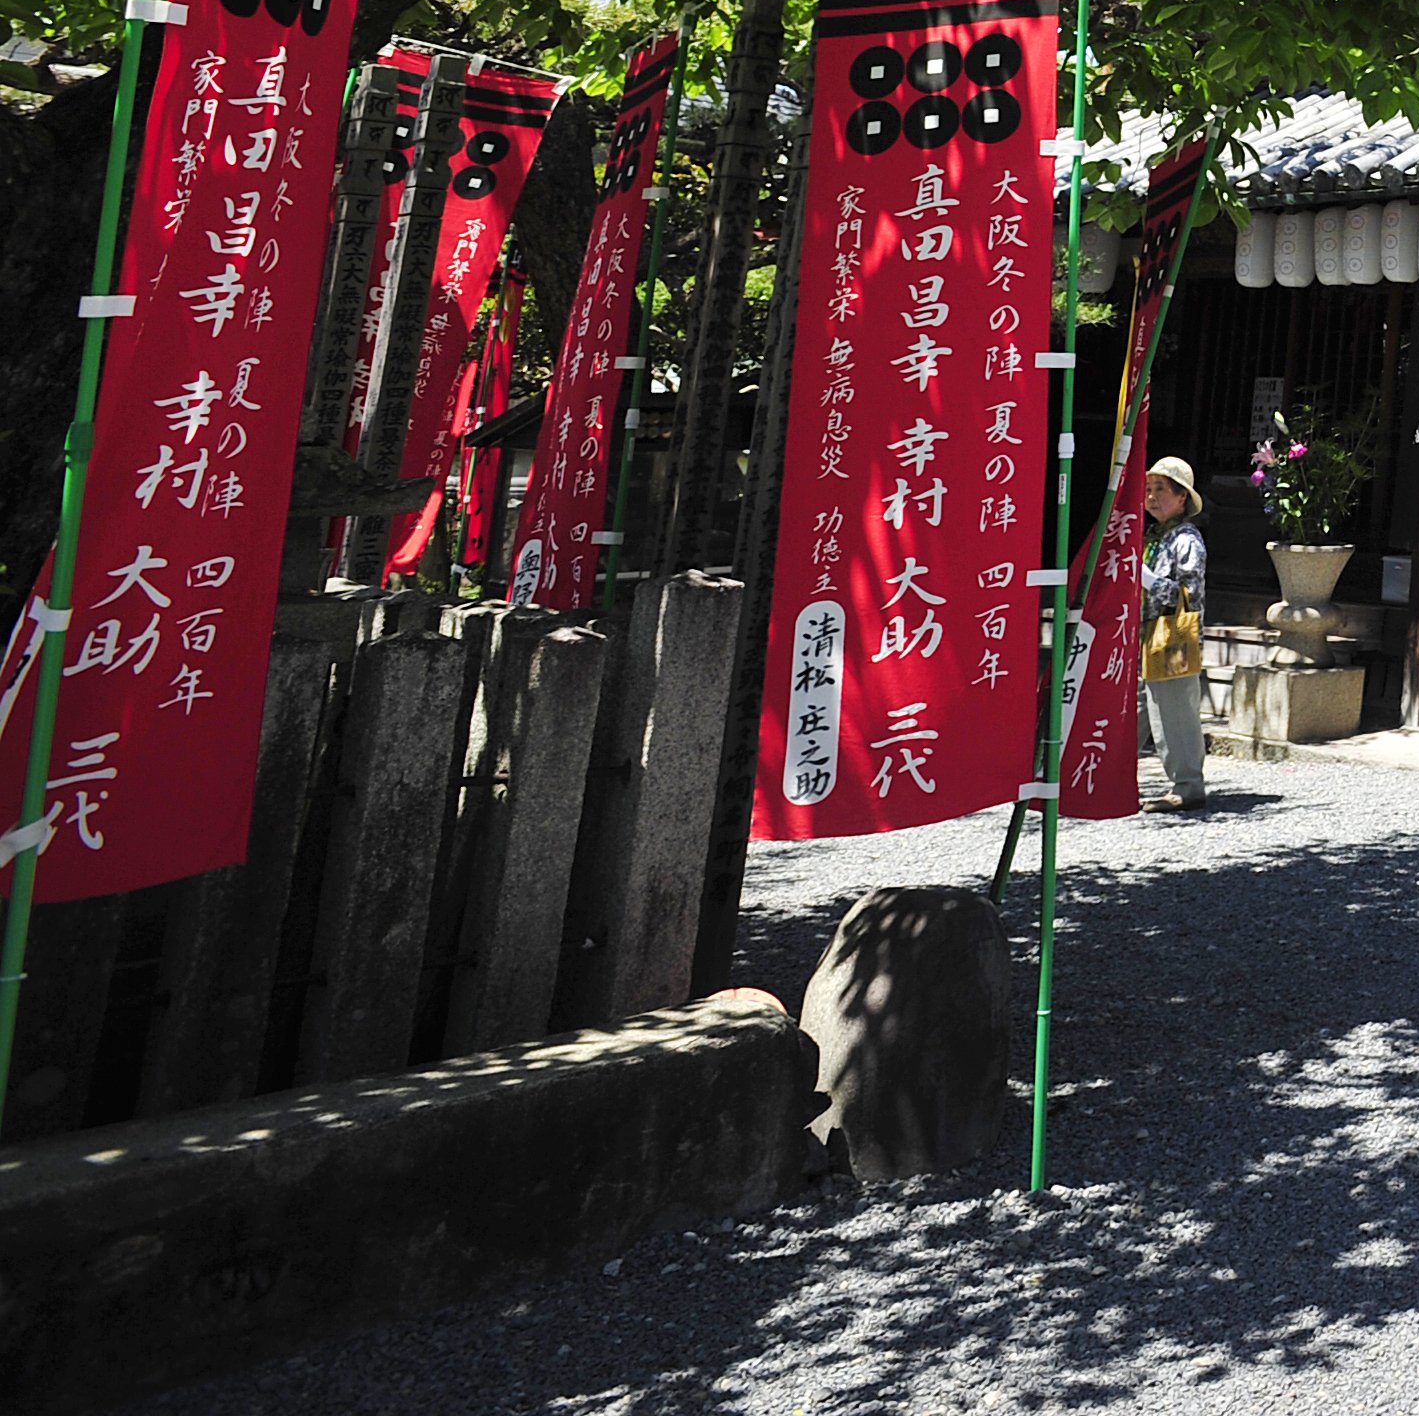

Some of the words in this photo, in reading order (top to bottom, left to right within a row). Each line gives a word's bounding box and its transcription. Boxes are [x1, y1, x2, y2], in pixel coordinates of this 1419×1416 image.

[164, 50, 226, 233] 家門繁栄
[177, 46, 290, 337] 真田昌幸
[243, 74, 312, 326] 大阪冬の陣
[587, 211, 629, 378] 大阪冬の陣
[828, 185, 866, 322] 家門繁栄
[891, 160, 959, 392] 真田昌幸
[985, 170, 1028, 381] 大阪冬の陣
[136, 371, 222, 509] 幸村
[202, 358, 261, 518] 夏の陣
[574, 395, 603, 497] 夏の陣
[818, 337, 854, 478] 無病息災
[980, 402, 1022, 532] 夏の陣
[882, 418, 948, 529] 幸村
[63, 546, 171, 676] 大助
[811, 506, 843, 594] 功徳主
[872, 557, 946, 662] 大助
[159, 556, 234, 714] 四百年
[795, 612, 840, 693] 清松
[972, 562, 1014, 689] 四百年
[1101, 604, 1128, 684] 大助
[38, 730, 122, 851] 三代
[791, 705, 831, 800] 庄之助
[871, 703, 938, 797] 三代
[1072, 720, 1108, 794] 三代
